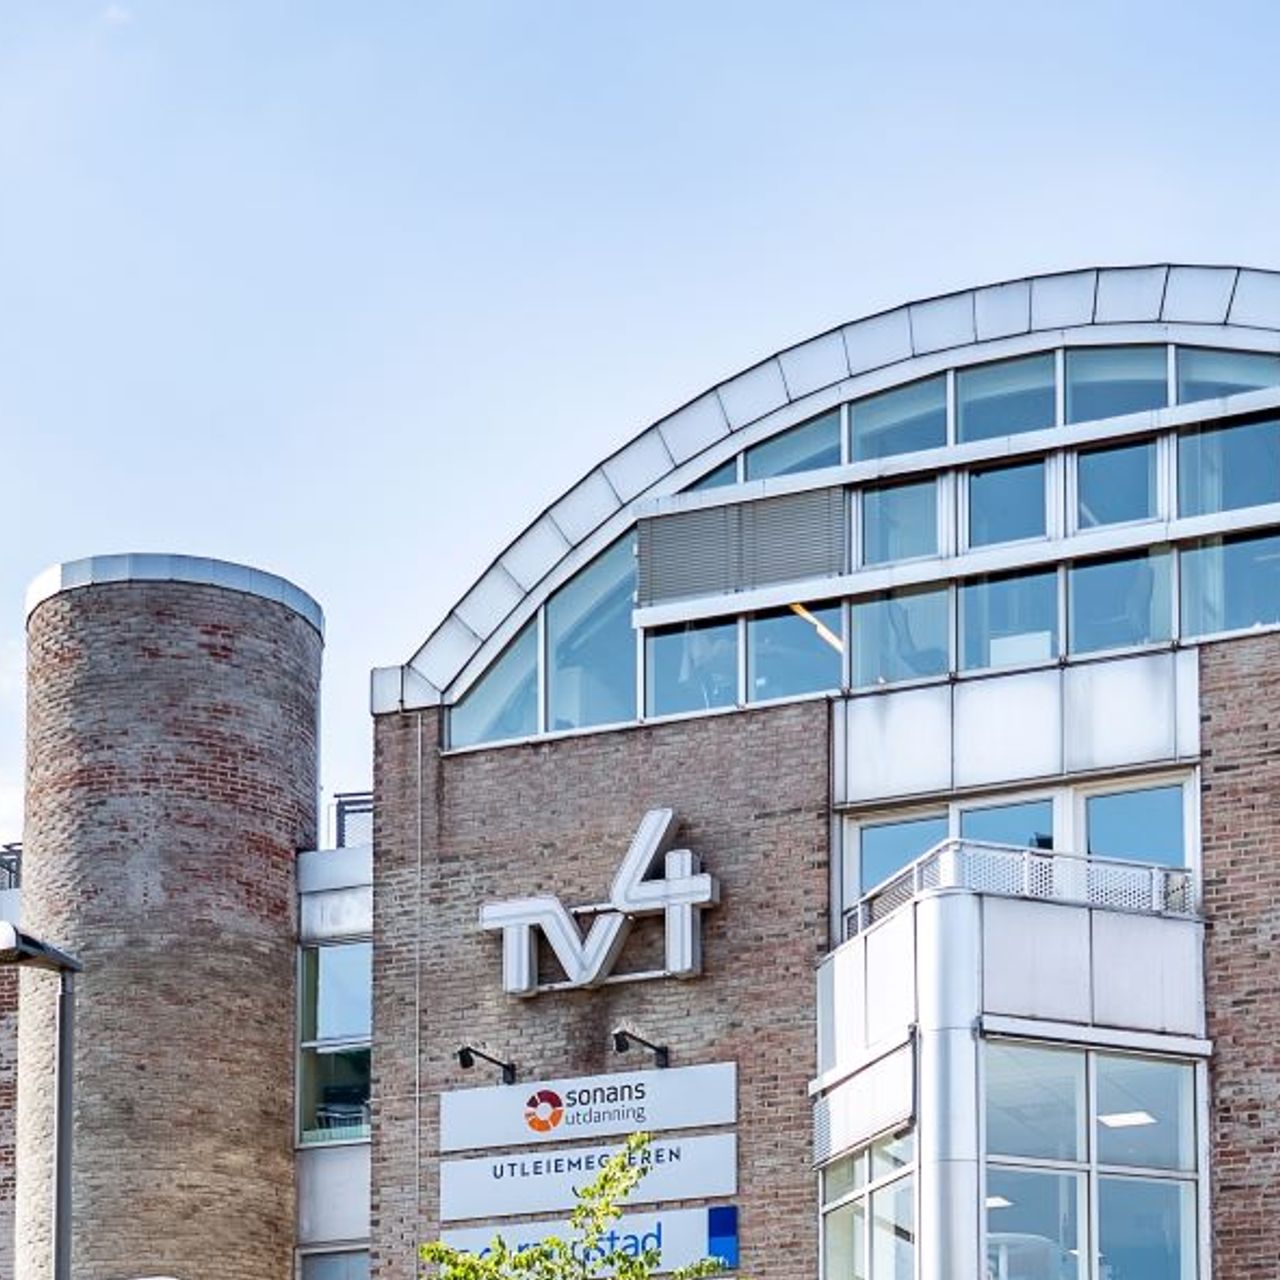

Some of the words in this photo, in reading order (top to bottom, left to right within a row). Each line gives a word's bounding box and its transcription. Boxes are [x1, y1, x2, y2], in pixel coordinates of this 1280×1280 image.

[480, 807, 718, 997] TV4
[564, 1082, 646, 1108] sonans
[564, 1104, 647, 1126] utdanning
[493, 1147, 682, 1179] UTLEIEMEGEREN
